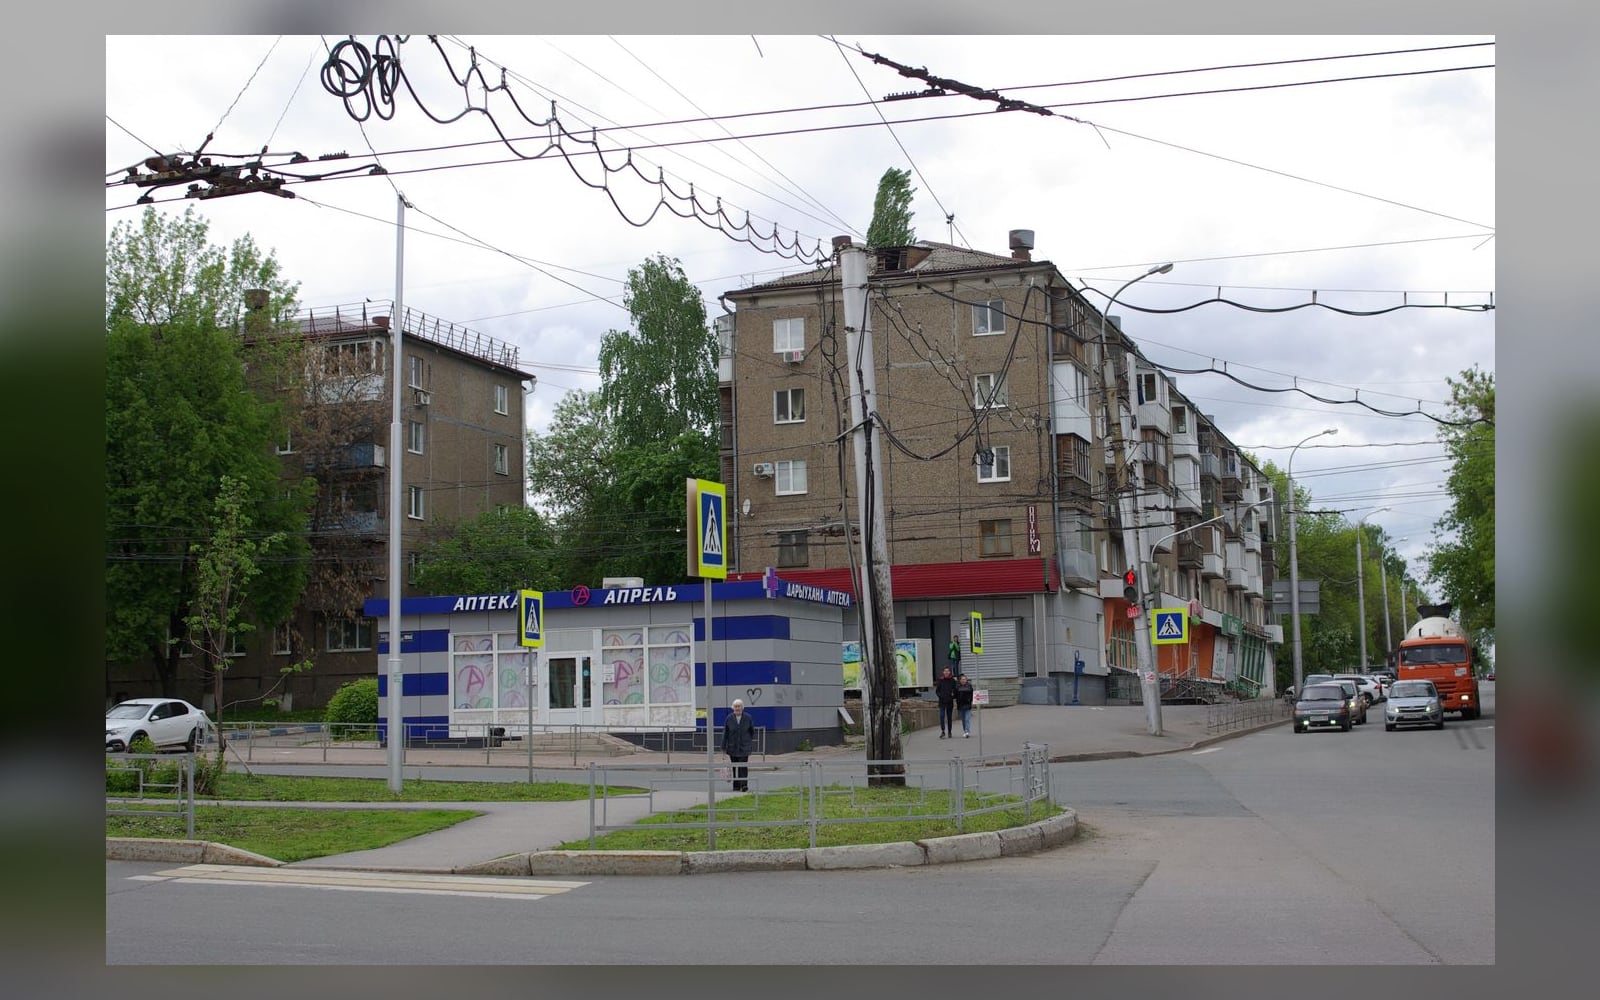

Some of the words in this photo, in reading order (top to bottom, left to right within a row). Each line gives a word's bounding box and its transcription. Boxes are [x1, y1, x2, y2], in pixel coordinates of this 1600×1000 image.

[604, 586, 677, 604] АПРЕЛЬ
[786, 583, 824, 602] ДАРЫУХАНА
[826, 590, 850, 606] АПТЕКА
